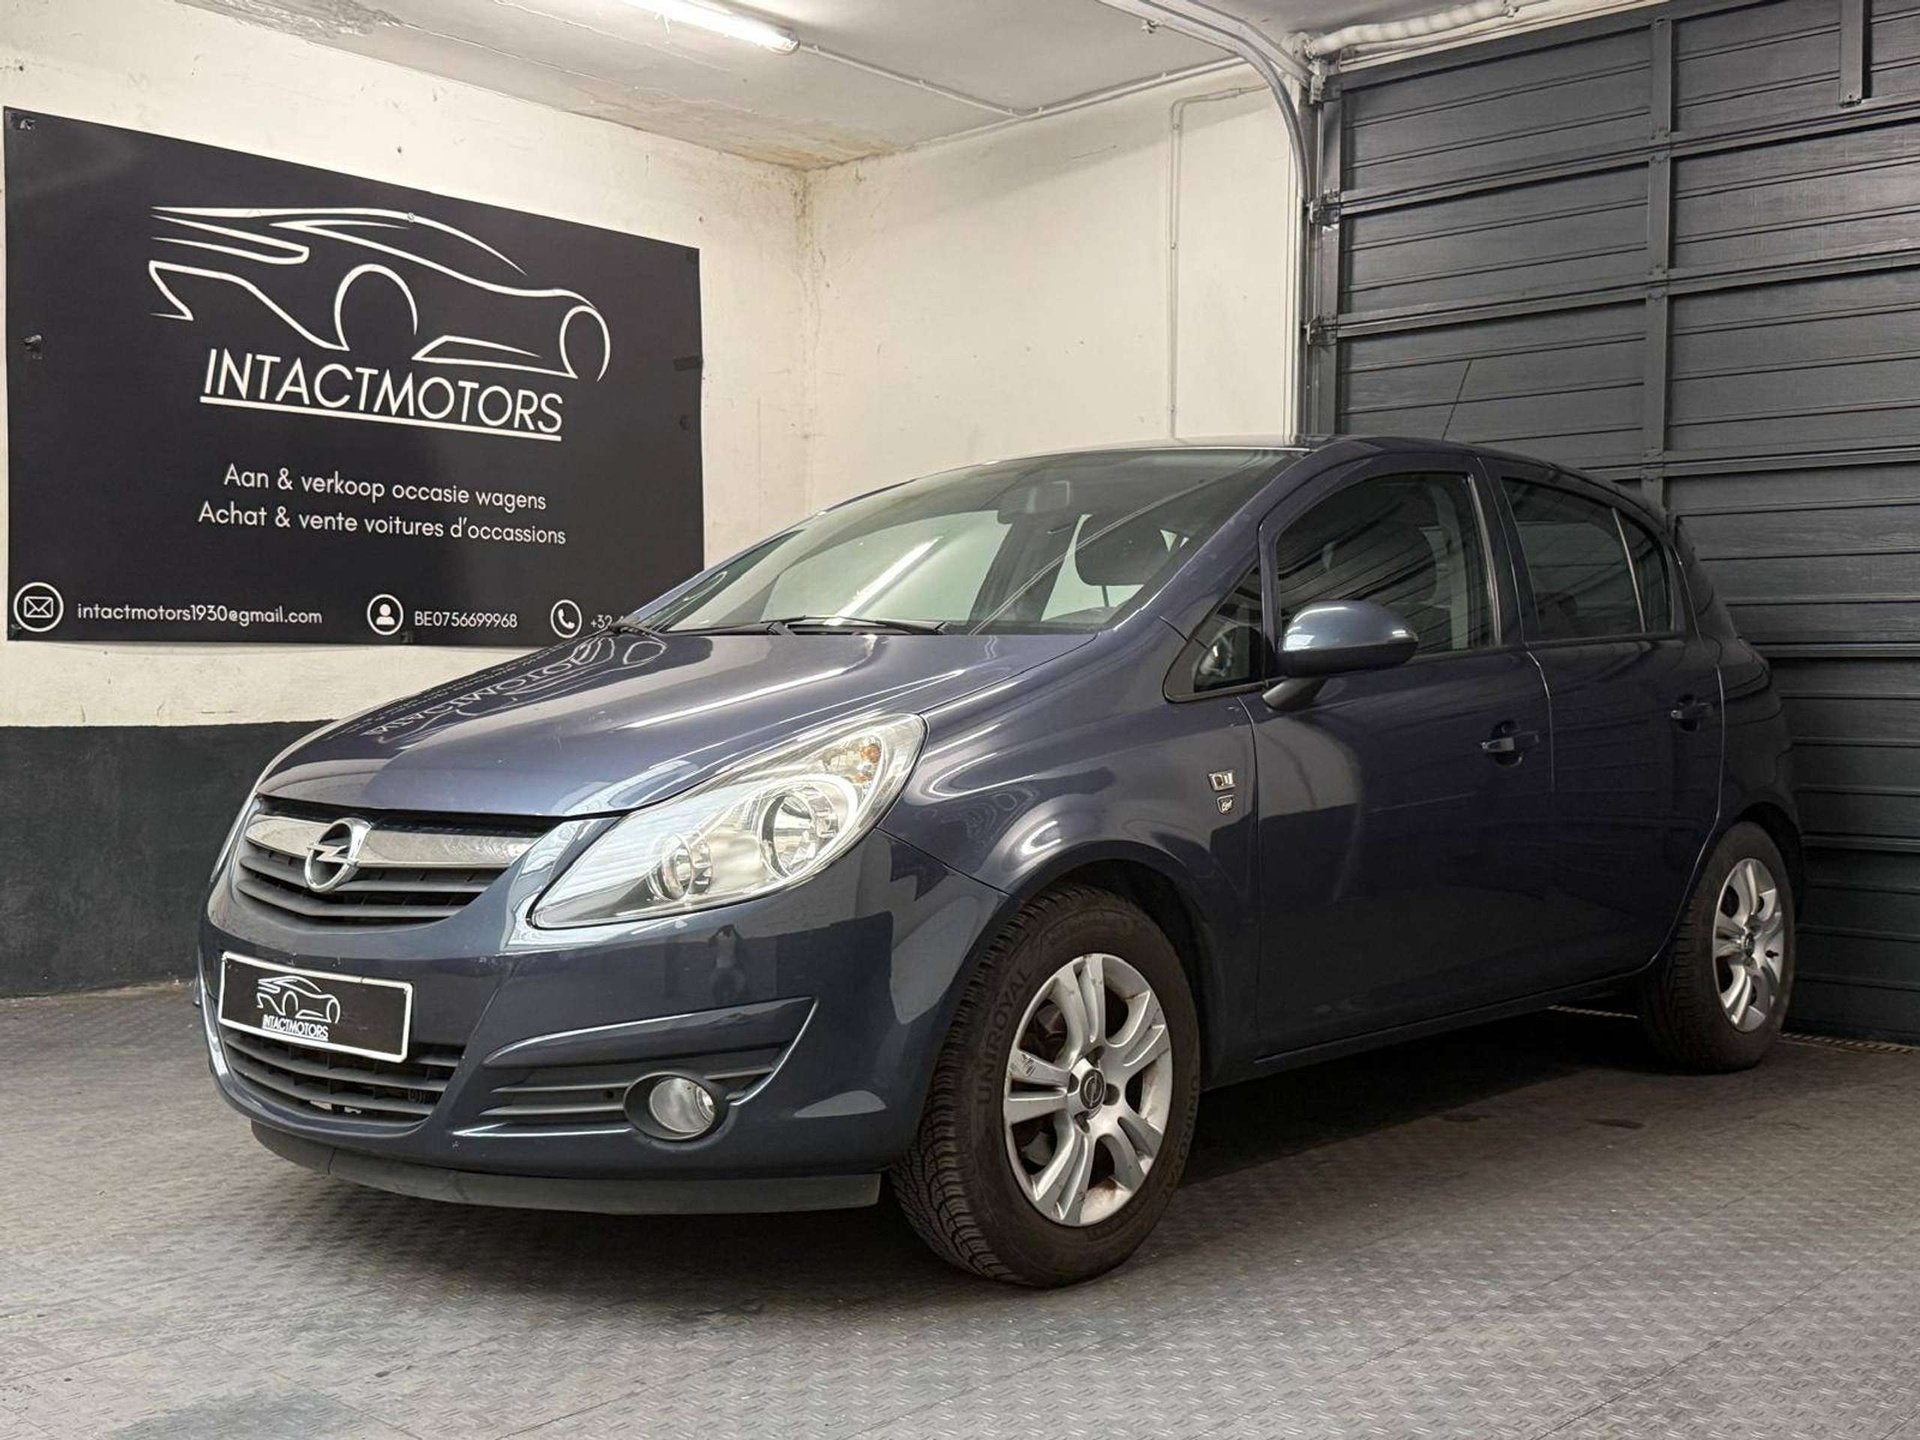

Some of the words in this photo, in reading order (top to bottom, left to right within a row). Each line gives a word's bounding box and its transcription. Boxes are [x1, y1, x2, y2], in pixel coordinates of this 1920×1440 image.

[204, 348, 563, 433] INTACTMOTORS
[223, 463, 269, 489] Aan
[277, 467, 293, 491] &
[300, 470, 385, 504] verkoop
[392, 484, 470, 504] occasie
[475, 491, 547, 514] wagens
[198, 500, 268, 526] Achat
[274, 505, 291, 528] &
[298, 512, 358, 532] vente
[364, 515, 444, 537] voitures
[450, 511, 567, 545] d'occassions
[77, 603, 323, 627] intactmotors1930@gmail.com
[414, 610, 518, 628] BE0756699968
[262, 1013, 329, 1039] INTACTMOTORS
[977, 968, 1034, 1105] UNIROYAL
